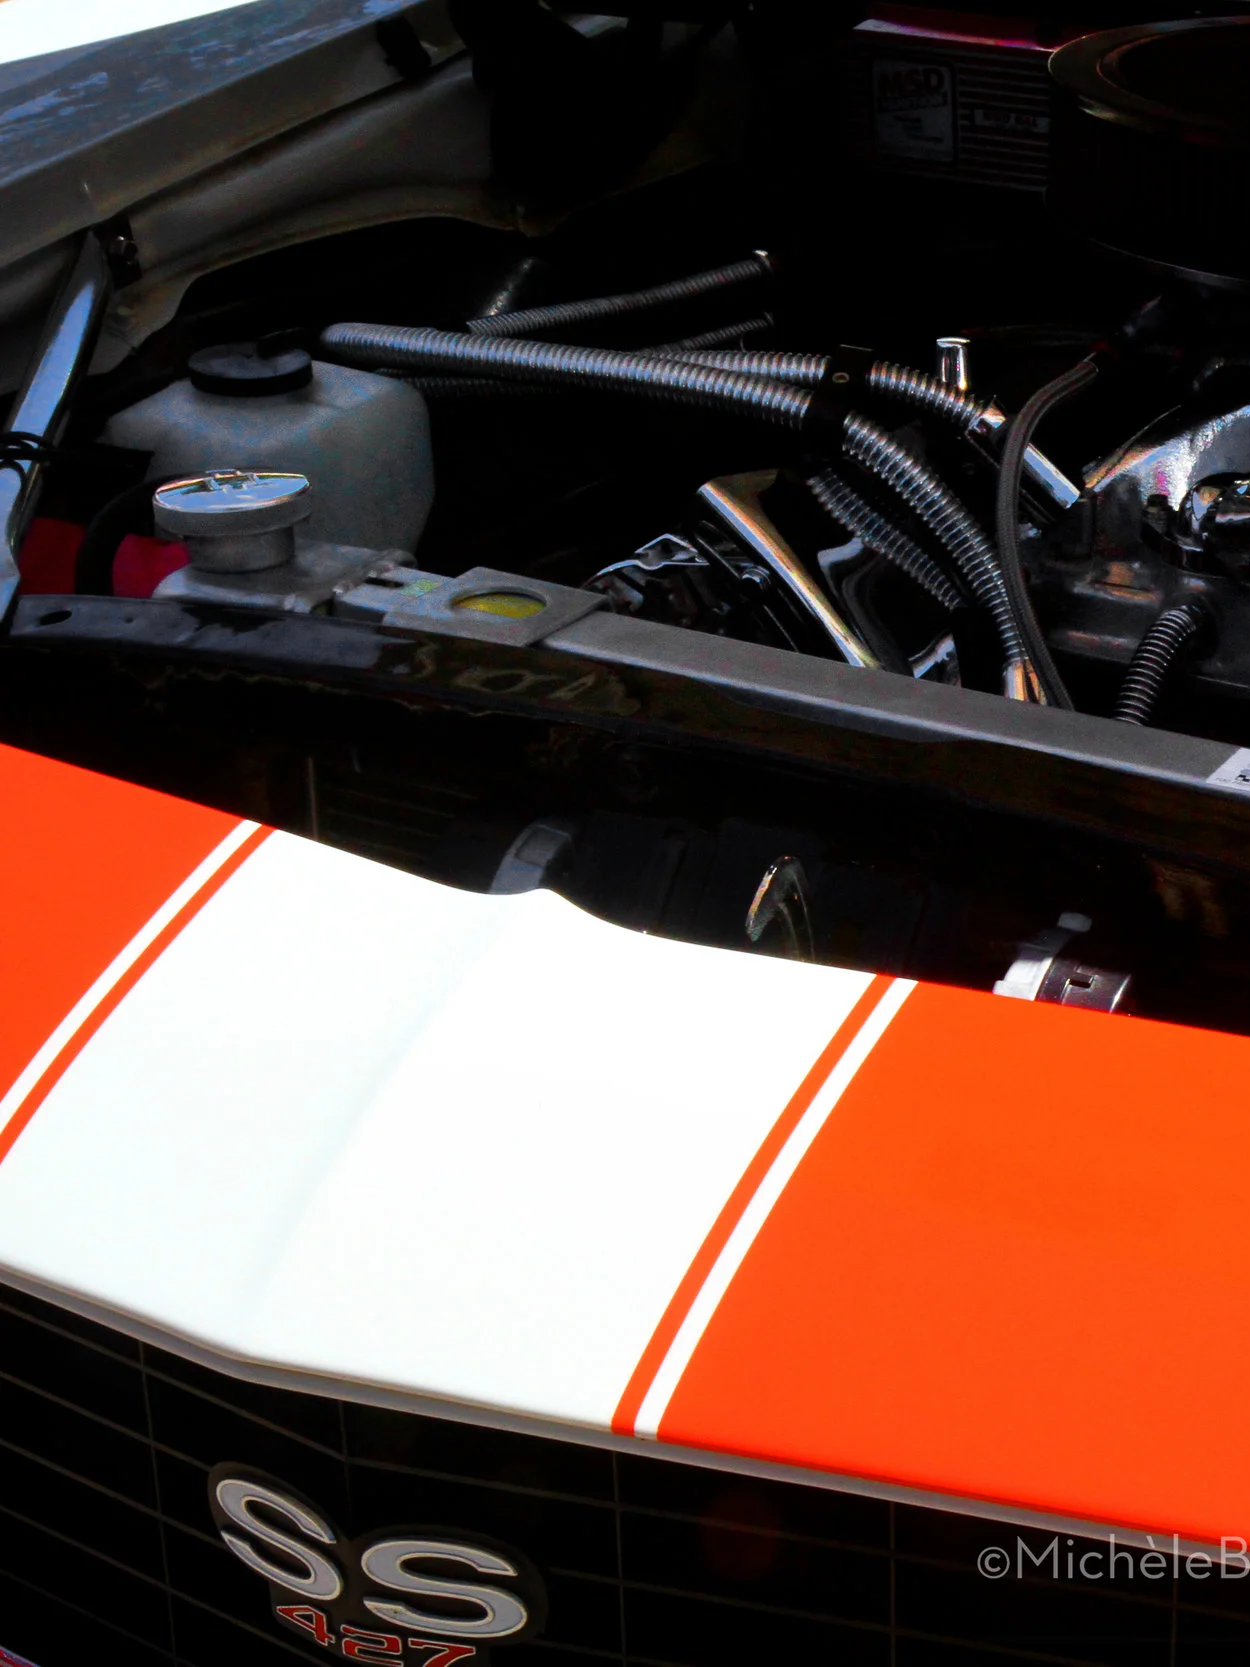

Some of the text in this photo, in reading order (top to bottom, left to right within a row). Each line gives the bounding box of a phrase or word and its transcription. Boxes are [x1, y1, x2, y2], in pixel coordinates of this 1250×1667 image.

[879, 67, 945, 98] MSD
[216, 1478, 530, 1638] SS
[275, 1604, 477, 1667] 427
